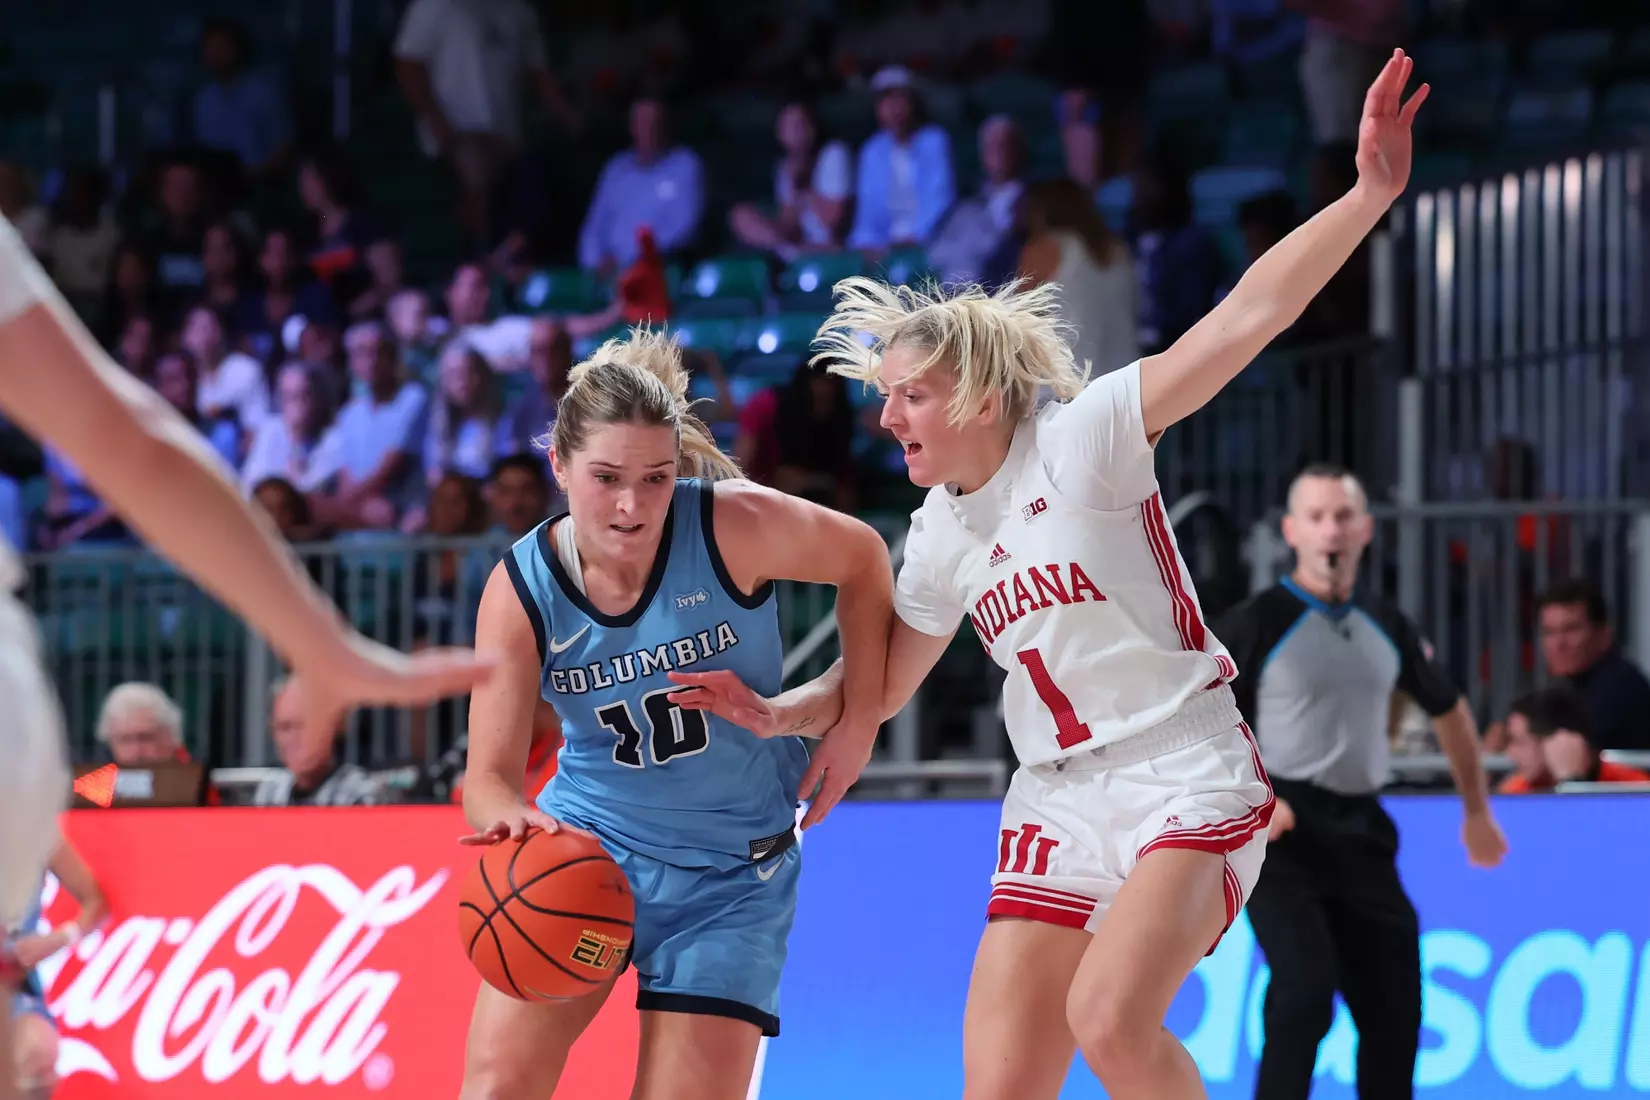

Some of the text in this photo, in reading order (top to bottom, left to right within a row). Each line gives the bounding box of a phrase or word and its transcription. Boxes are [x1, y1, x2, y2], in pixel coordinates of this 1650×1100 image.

[988, 552, 1012, 568] adidas
[675, 594, 697, 608] Ivy
[971, 563, 1107, 656] NDIANA
[550, 621, 739, 694] COLUMBIA
[594, 684, 710, 769] 10
[1016, 648, 1093, 750] 1
[38, 863, 451, 1084] ca-Cola
[570, 935, 626, 969] ELIT
